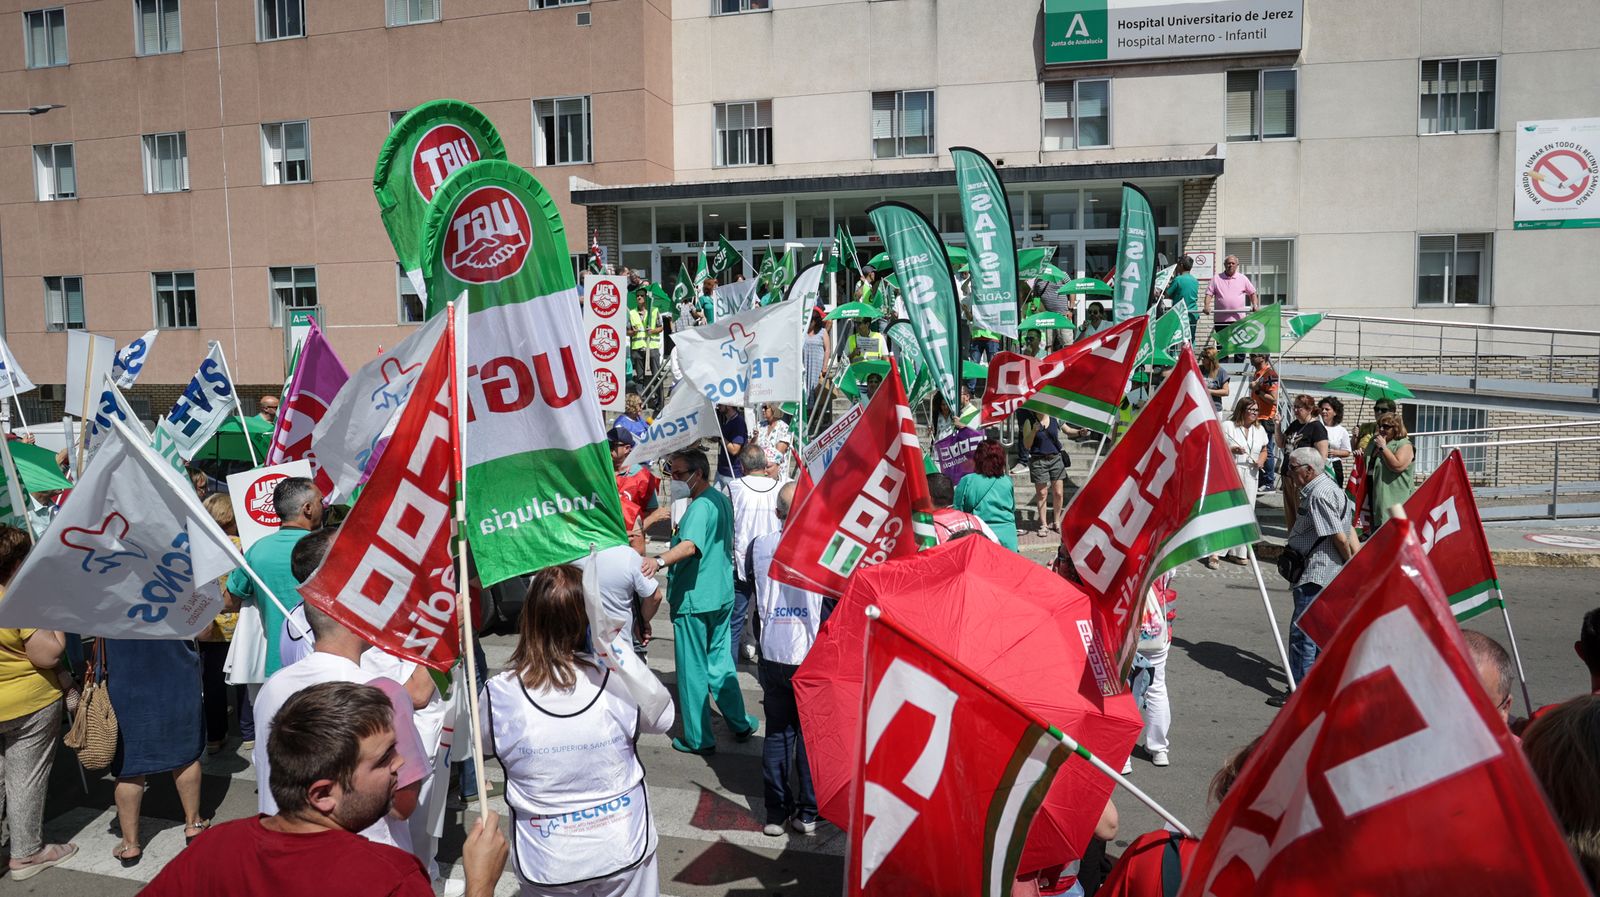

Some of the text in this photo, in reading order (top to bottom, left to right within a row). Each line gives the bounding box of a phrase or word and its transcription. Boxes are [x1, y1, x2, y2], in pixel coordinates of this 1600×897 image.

[1117, 9, 1294, 30] Hospital Universitario de Jerez
[1117, 34, 1165, 48] Hospital
[1168, 32, 1215, 44] Materno
[1225, 28, 1267, 41] Infantil
[1522, 141, 1599, 206] PROHIBIDO FUMAR EN TODO EL RECINTO SANITARIO
[596, 284, 615, 296] UGT
[595, 327, 614, 339] UGT
[820, 409, 860, 447] CCOO
[552, 743, 588, 754] SUPERIOR
